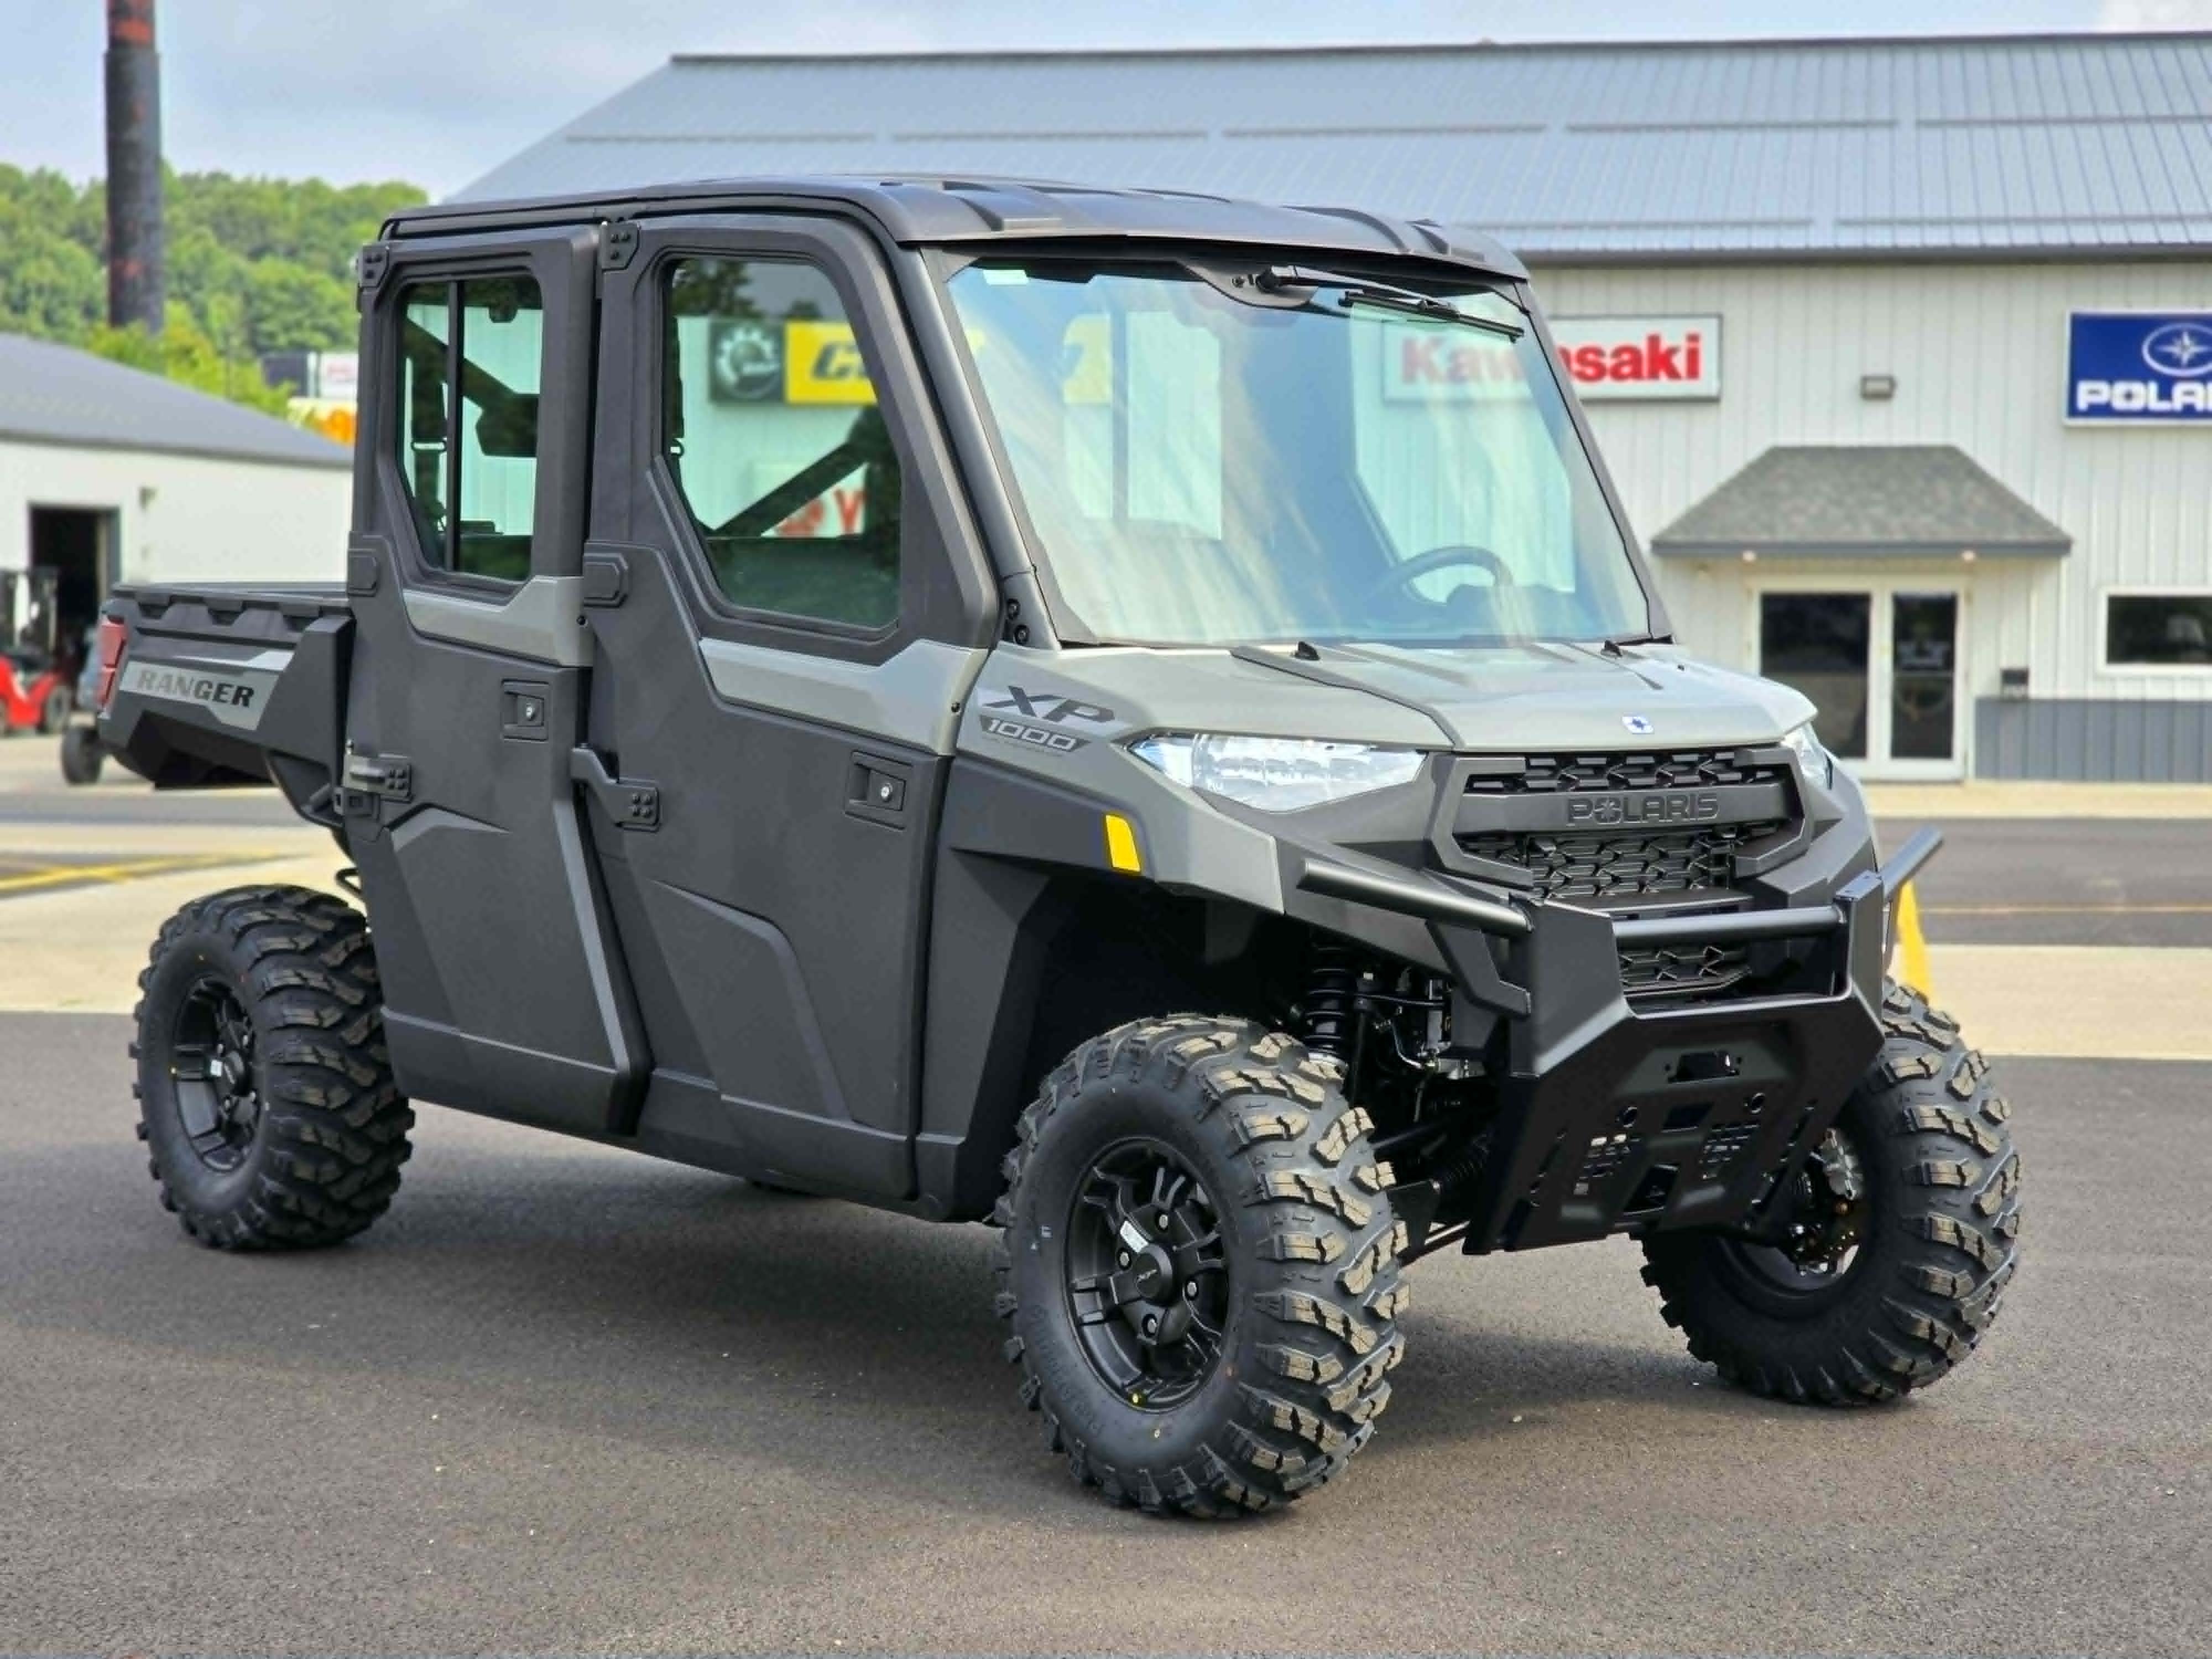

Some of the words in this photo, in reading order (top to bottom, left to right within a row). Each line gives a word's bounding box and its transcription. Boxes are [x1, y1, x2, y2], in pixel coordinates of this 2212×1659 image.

[1402, 333, 1702, 383] Kawsaki
[2077, 380, 2212, 411] POLA
[138, 669, 255, 707] RANGER
[983, 685, 1115, 723] XP
[988, 719, 1077, 752] 1000
[1566, 790, 1719, 827] POLARIS
